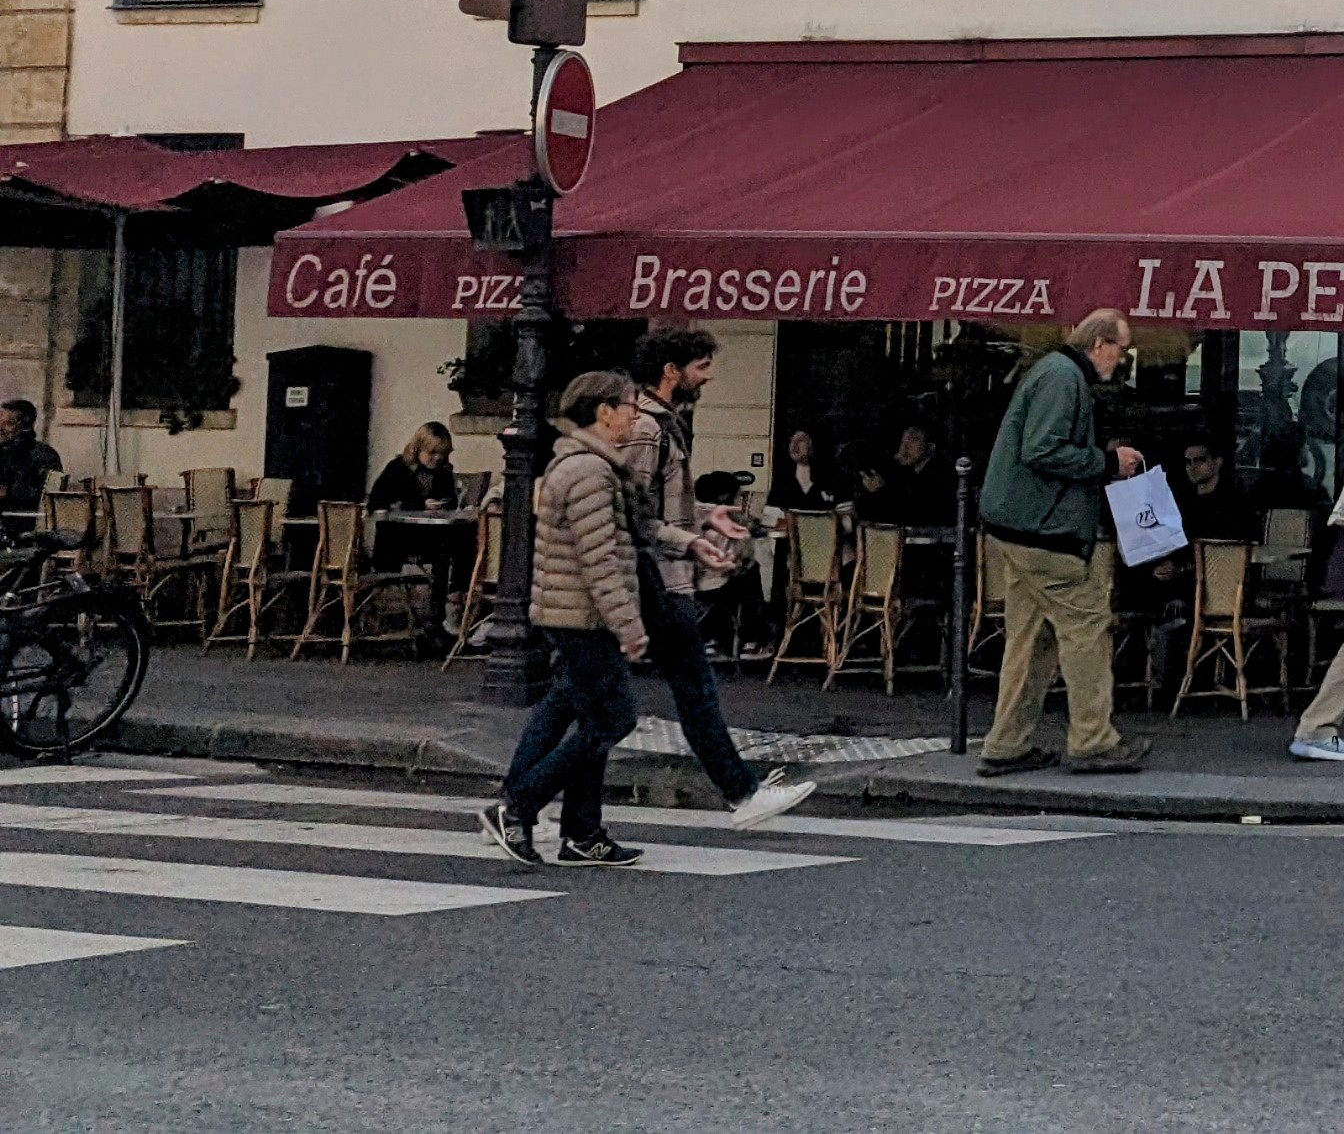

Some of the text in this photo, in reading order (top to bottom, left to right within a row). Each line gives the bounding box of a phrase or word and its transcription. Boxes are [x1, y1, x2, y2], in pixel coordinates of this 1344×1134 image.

[286, 253, 398, 309] Café
[629, 255, 868, 312] Brasserie
[928, 276, 1056, 315] PIZZA
[1129, 258, 1231, 319] LA
